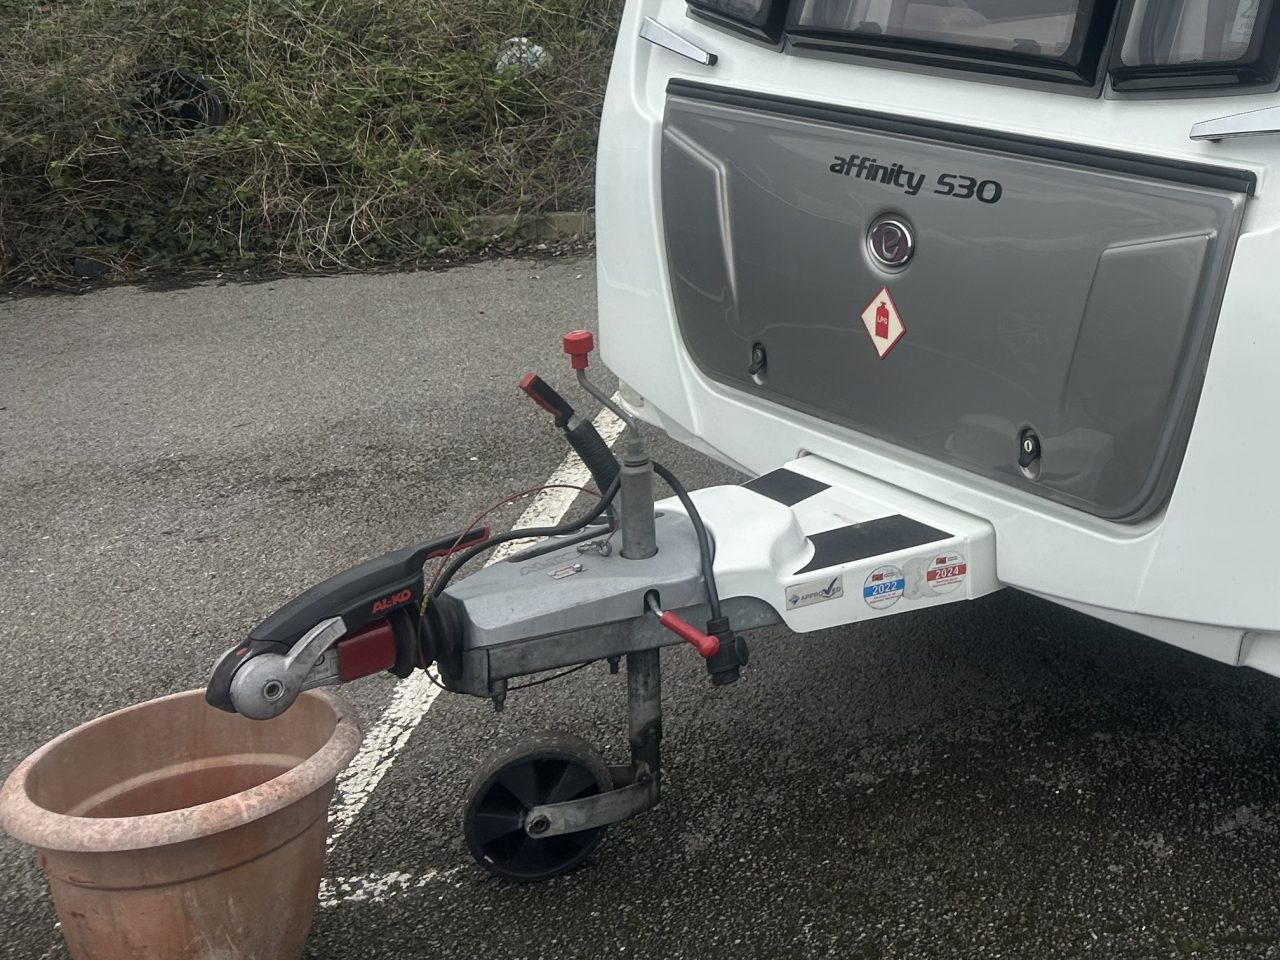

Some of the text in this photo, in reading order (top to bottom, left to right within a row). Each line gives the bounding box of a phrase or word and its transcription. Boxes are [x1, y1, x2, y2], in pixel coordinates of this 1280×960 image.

[829, 154, 1003, 204] affinity 530
[935, 566, 959, 579] 2024
[801, 587, 842, 600] APPROED
[872, 581, 897, 595] 2022
